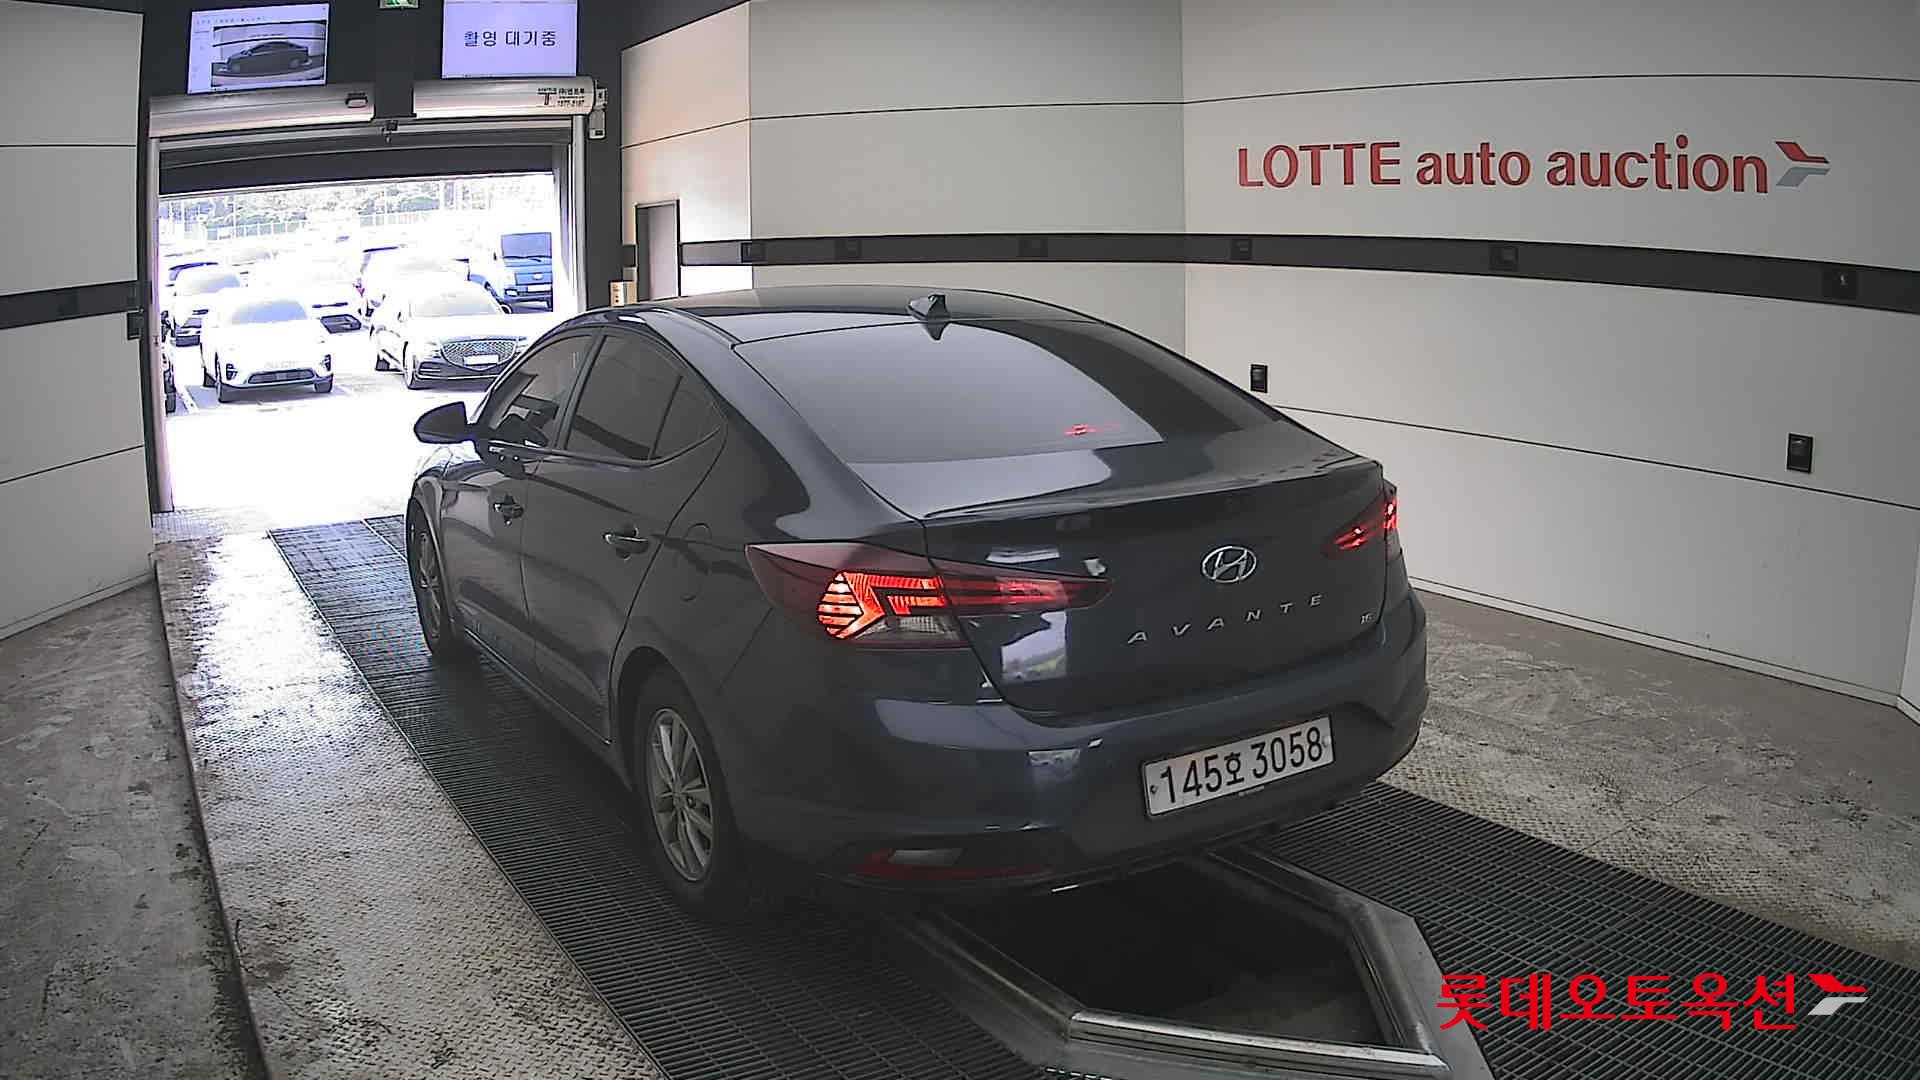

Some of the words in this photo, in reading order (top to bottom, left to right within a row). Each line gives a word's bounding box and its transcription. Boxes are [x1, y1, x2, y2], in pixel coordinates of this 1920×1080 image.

[505, 31, 557, 48] 대기중
[1239, 142, 1399, 187] LOTTE
[1417, 143, 1531, 186] auto
[1547, 136, 1767, 193] auction
[1128, 594, 1323, 644] AVANTE
[1160, 752, 1245, 803] 145호
[1251, 726, 1323, 779] 3058
